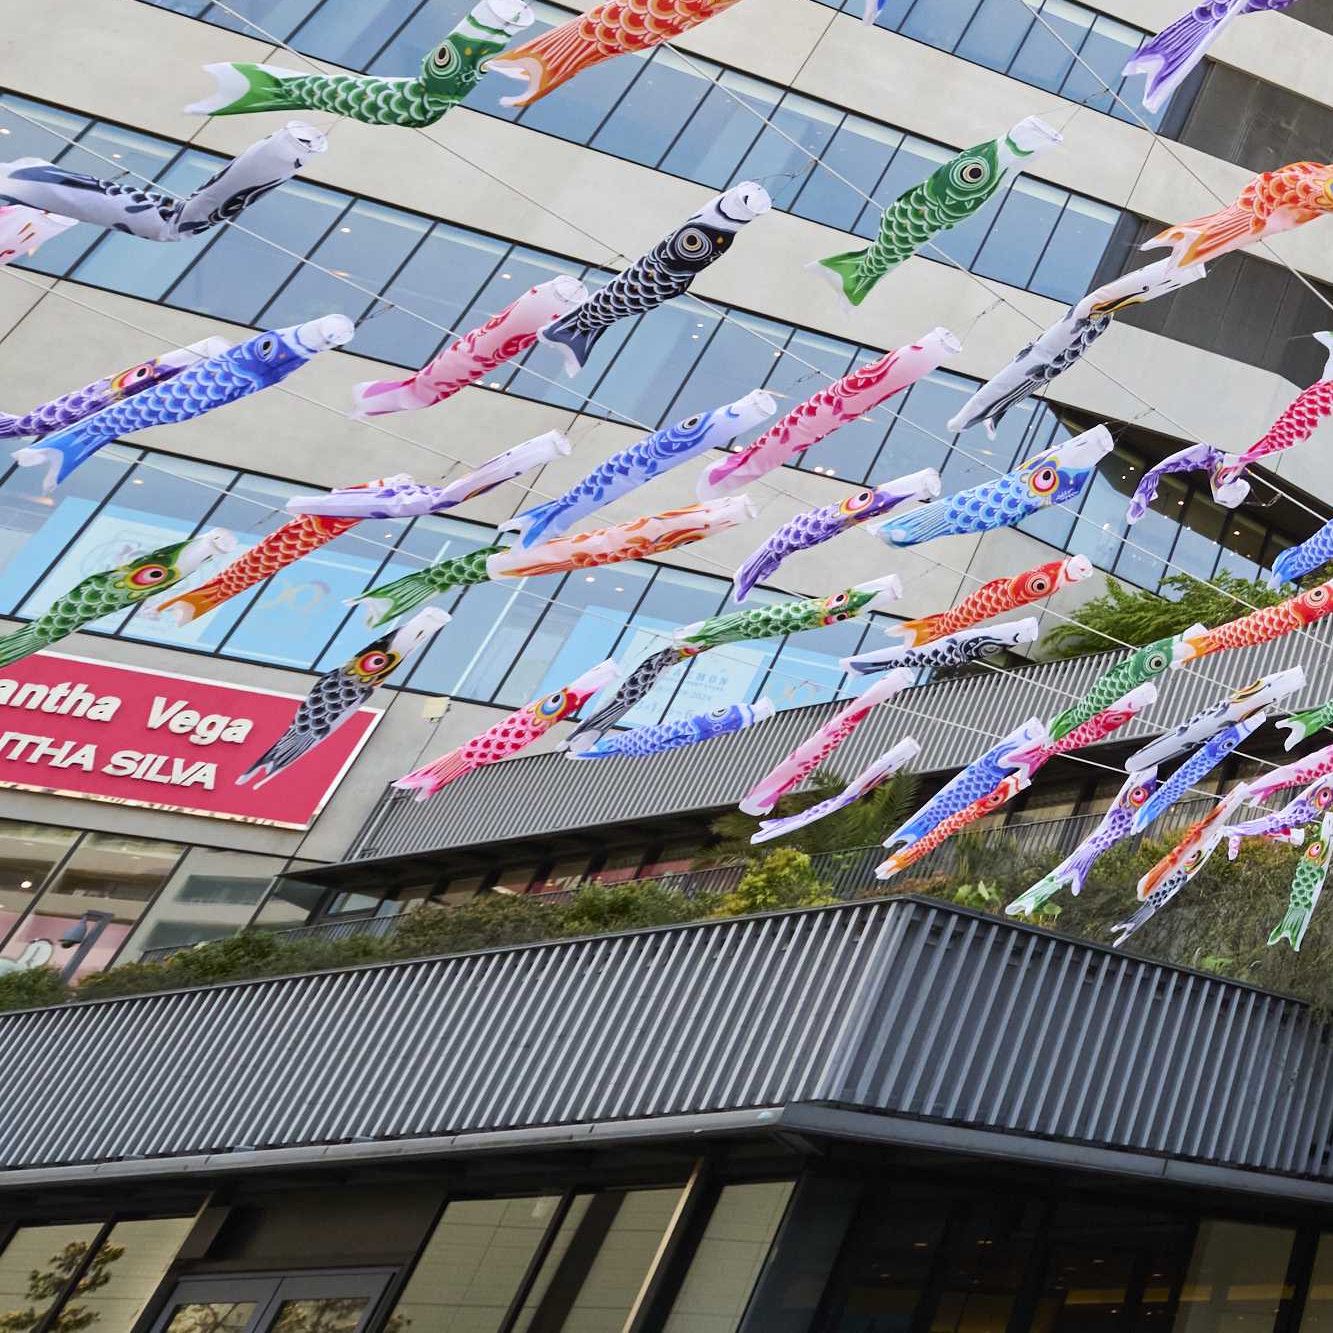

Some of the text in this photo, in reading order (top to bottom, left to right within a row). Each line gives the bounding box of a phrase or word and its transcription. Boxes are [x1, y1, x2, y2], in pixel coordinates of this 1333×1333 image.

[147, 696, 254, 745] Vega
[0, 731, 218, 790] THA SILVA
